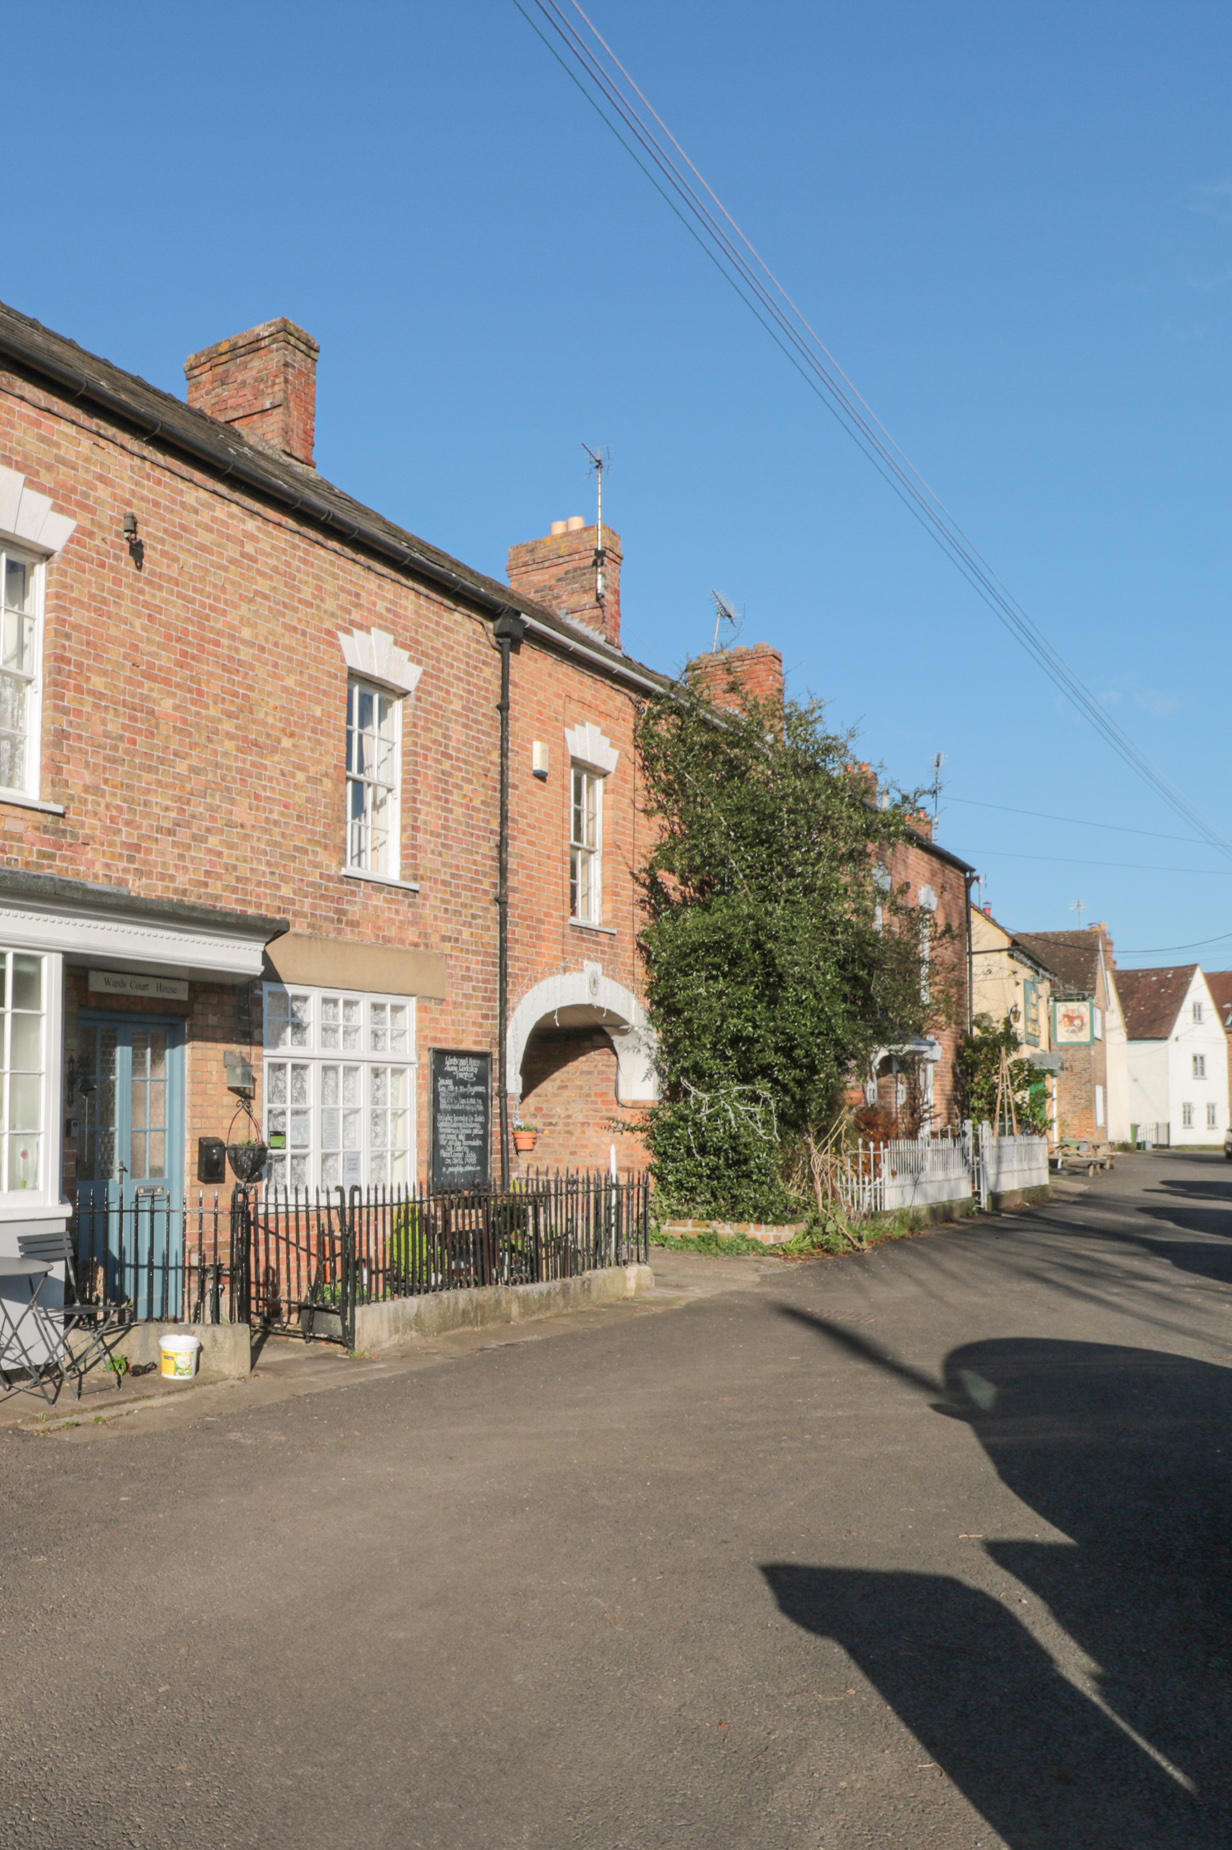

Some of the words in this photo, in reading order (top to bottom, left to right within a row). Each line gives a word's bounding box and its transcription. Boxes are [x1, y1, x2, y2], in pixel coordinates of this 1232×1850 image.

[104, 977, 126, 989] Wards
[129, 980, 149, 991] Court
[156, 983, 177, 994] House
